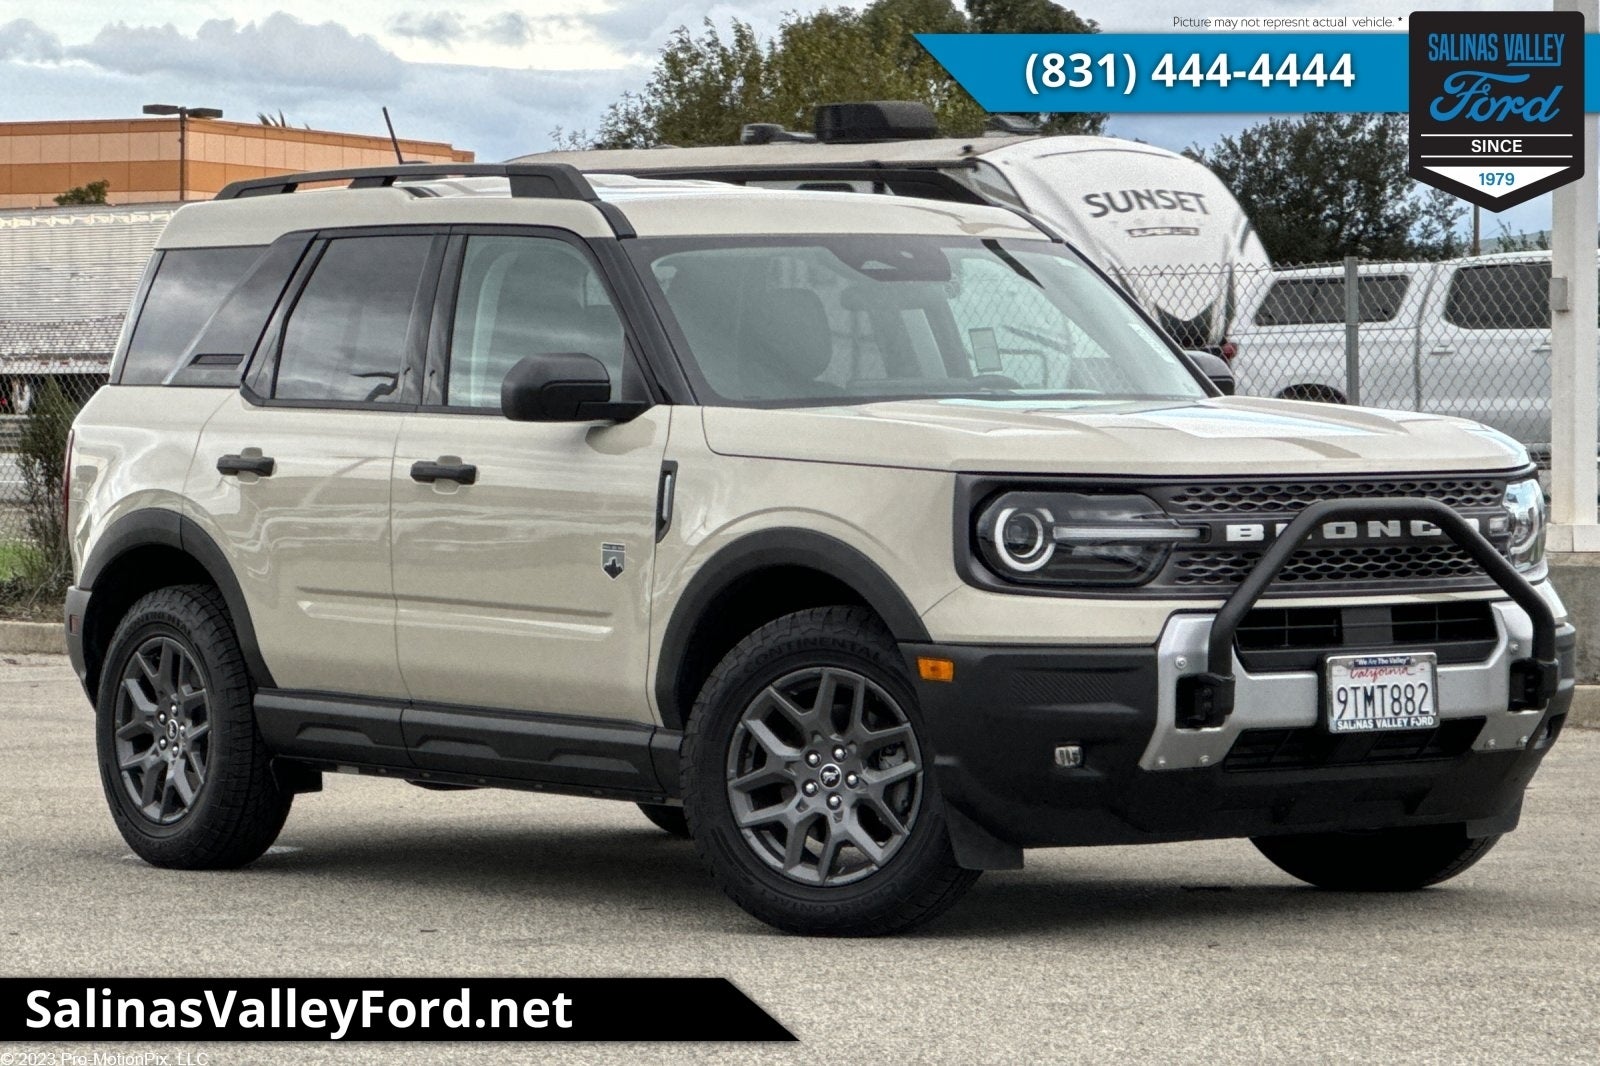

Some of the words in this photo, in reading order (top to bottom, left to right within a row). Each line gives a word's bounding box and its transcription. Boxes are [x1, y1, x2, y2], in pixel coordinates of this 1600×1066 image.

[1083, 189, 1210, 218] SUNSET
[1350, 666, 1416, 683] California
[1337, 682, 1430, 720] 9TMT882
[1337, 719, 1375, 731] SALINAS
[1375, 718, 1408, 729] VALLEY
[1410, 716, 1435, 727] FORD
